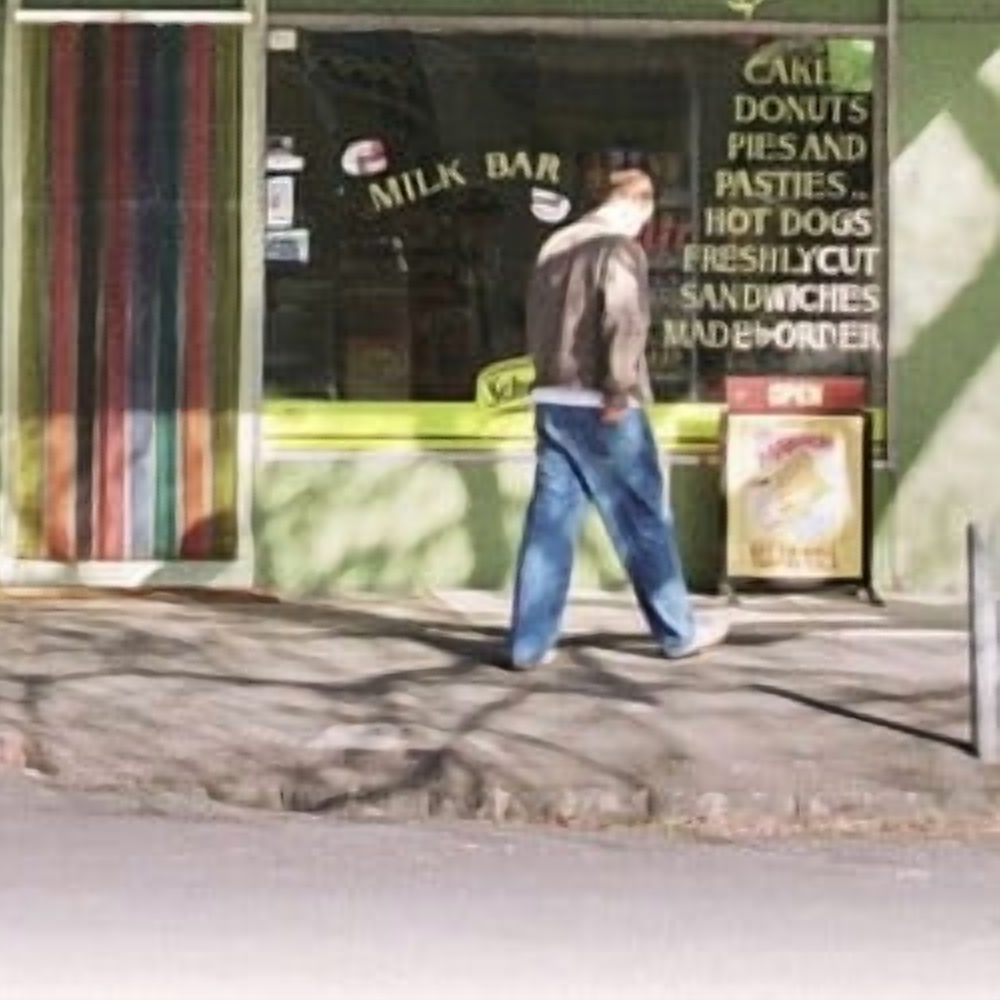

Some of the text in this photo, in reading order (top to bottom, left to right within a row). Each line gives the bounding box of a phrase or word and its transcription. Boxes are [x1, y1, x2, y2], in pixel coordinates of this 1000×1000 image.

[734, 94, 869, 124] DONUTS
[728, 131, 867, 161] PIES AND
[368, 150, 561, 212] MILK BAR
[704, 207, 873, 237] HOT DOGS
[816, 245, 881, 275] CUT
[680, 282, 881, 313] SANDWICHES
[774, 319, 881, 349] ORDER
